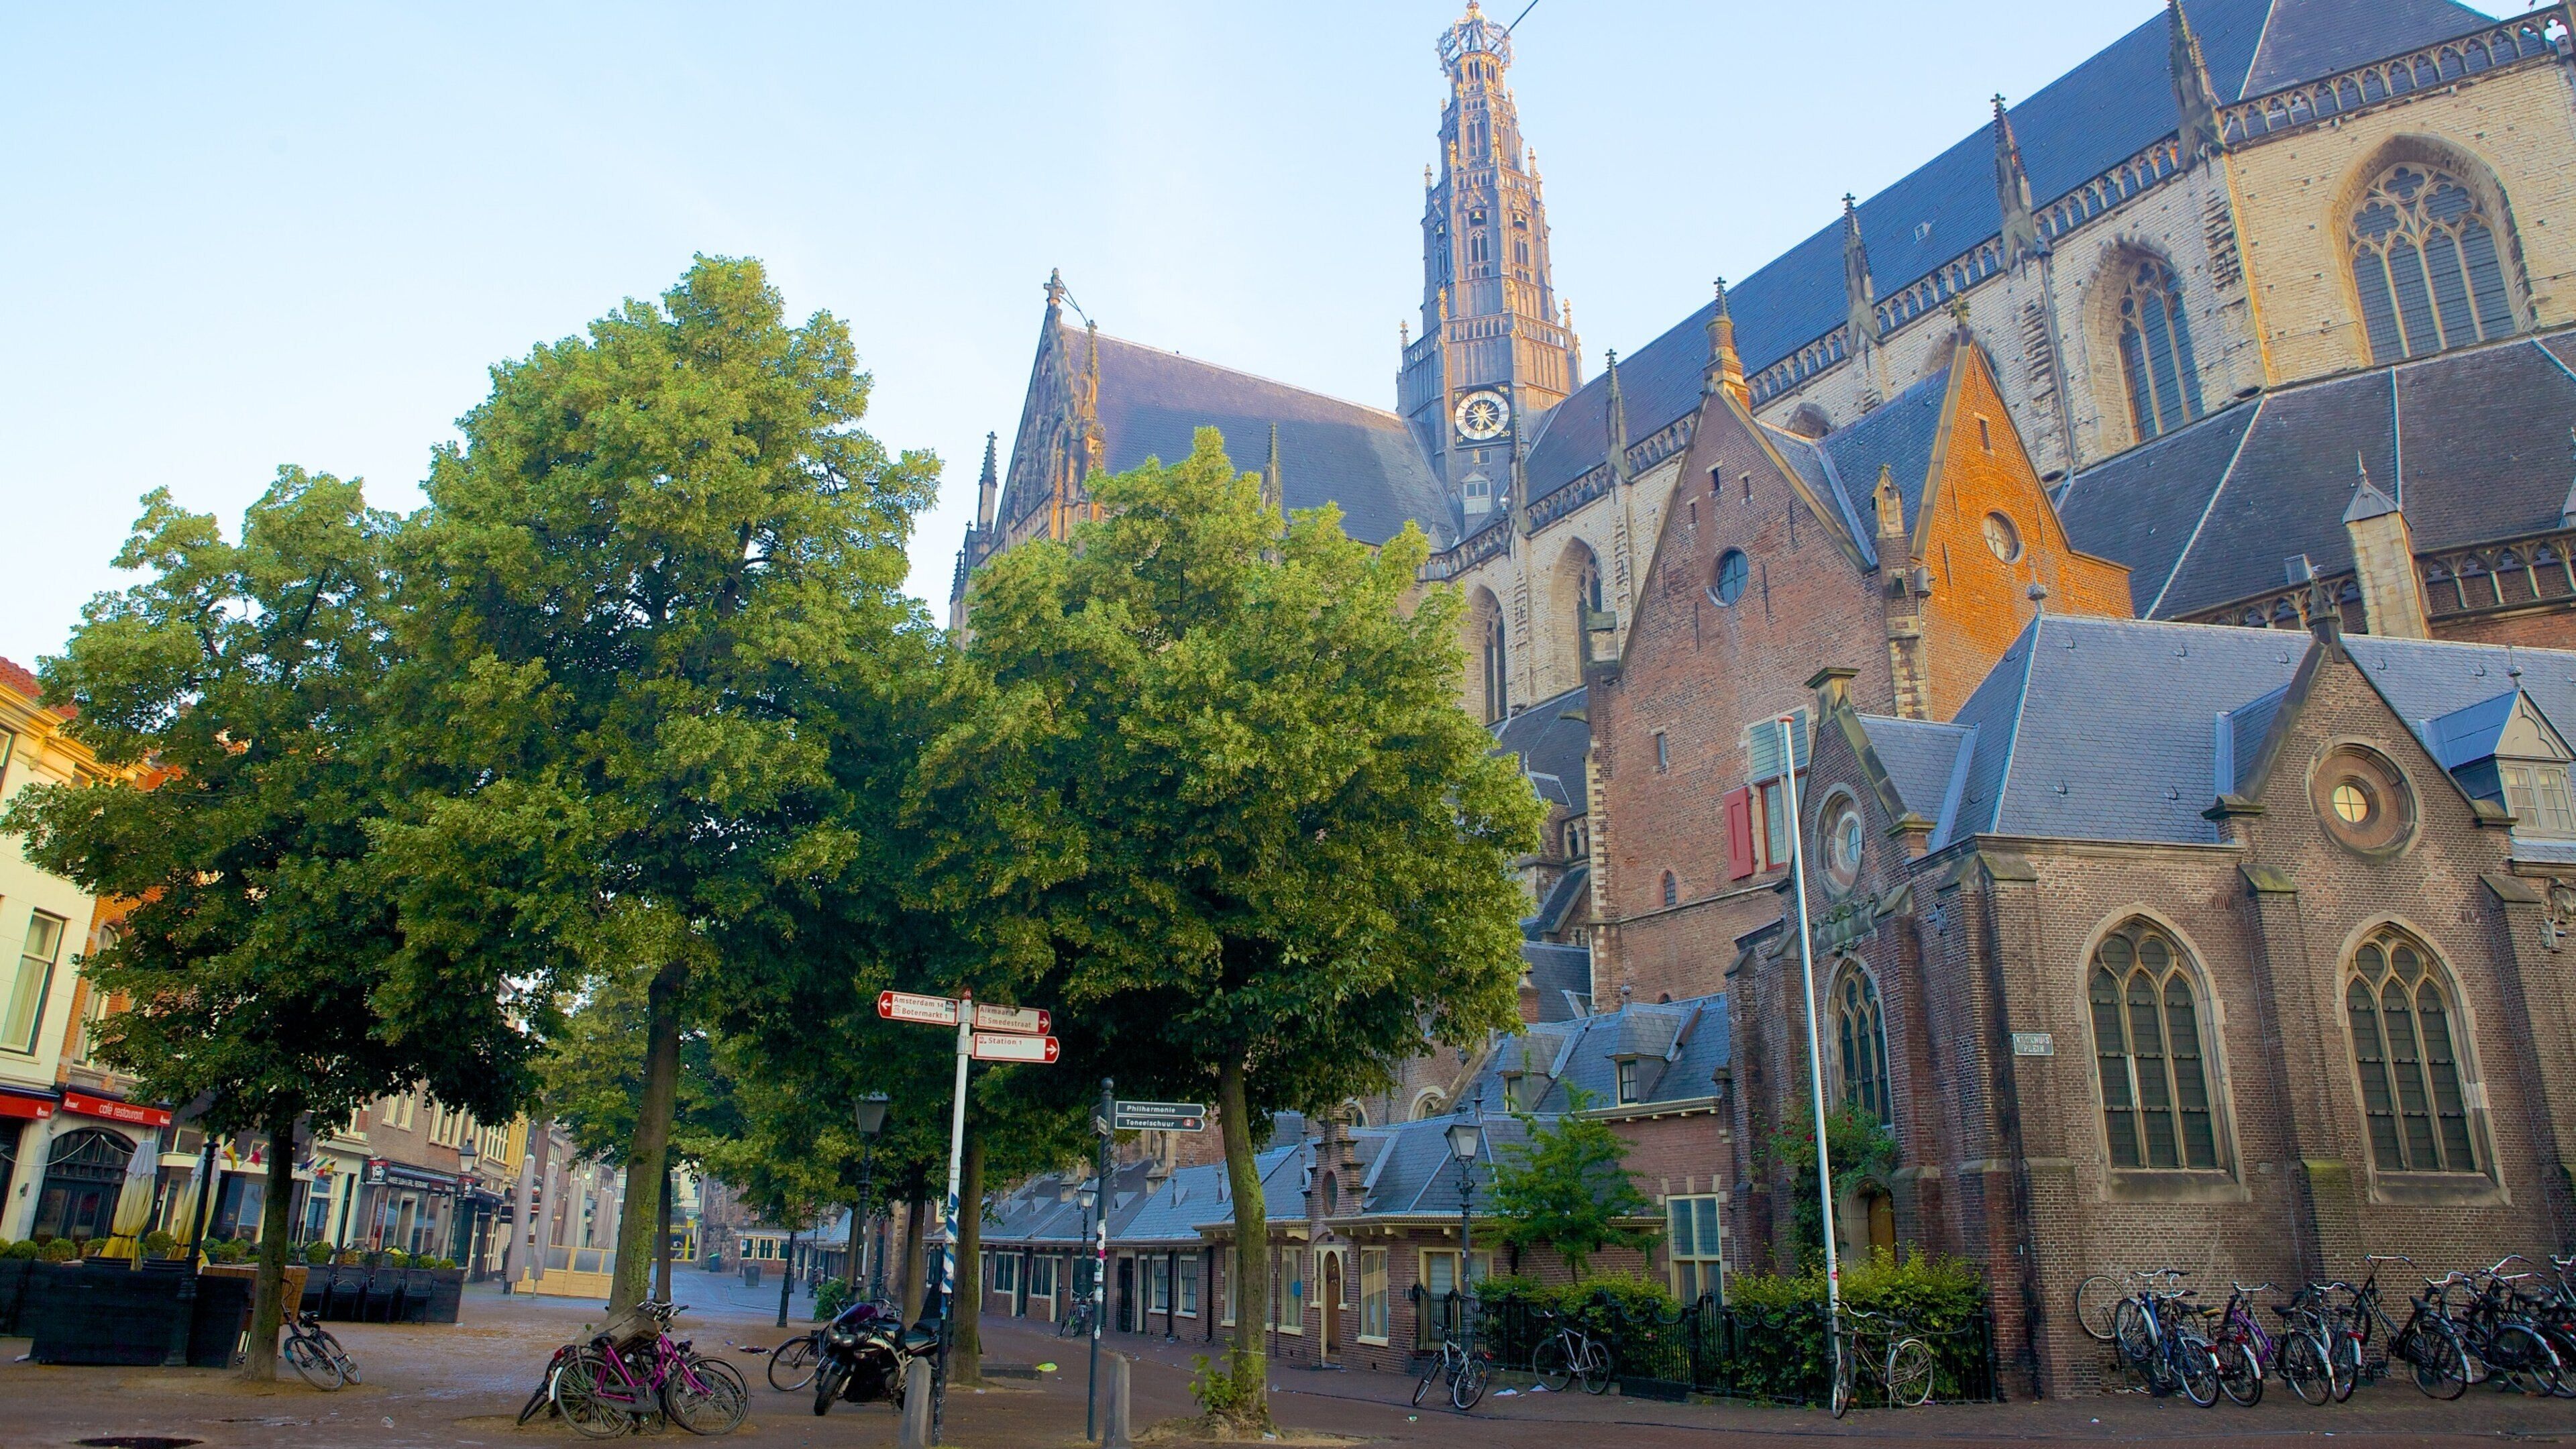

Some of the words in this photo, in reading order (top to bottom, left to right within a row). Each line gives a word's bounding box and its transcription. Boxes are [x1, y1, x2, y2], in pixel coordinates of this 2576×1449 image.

[894, 996, 934, 1007] Amsterdam
[902, 1008, 943, 1018] Botermarkt
[980, 1006, 1009, 1016] Alkmaar
[987, 1017, 1032, 1028] Smedestraat
[989, 1036, 1017, 1045] Station
[2023, 1044, 2045, 1053] PLEIN
[99, 1102, 113, 1116] café
[113, 1106, 144, 1122] restaurant
[1126, 1104, 1176, 1114] Philharmonie
[1126, 1118, 1175, 1128] Toneelschuur
